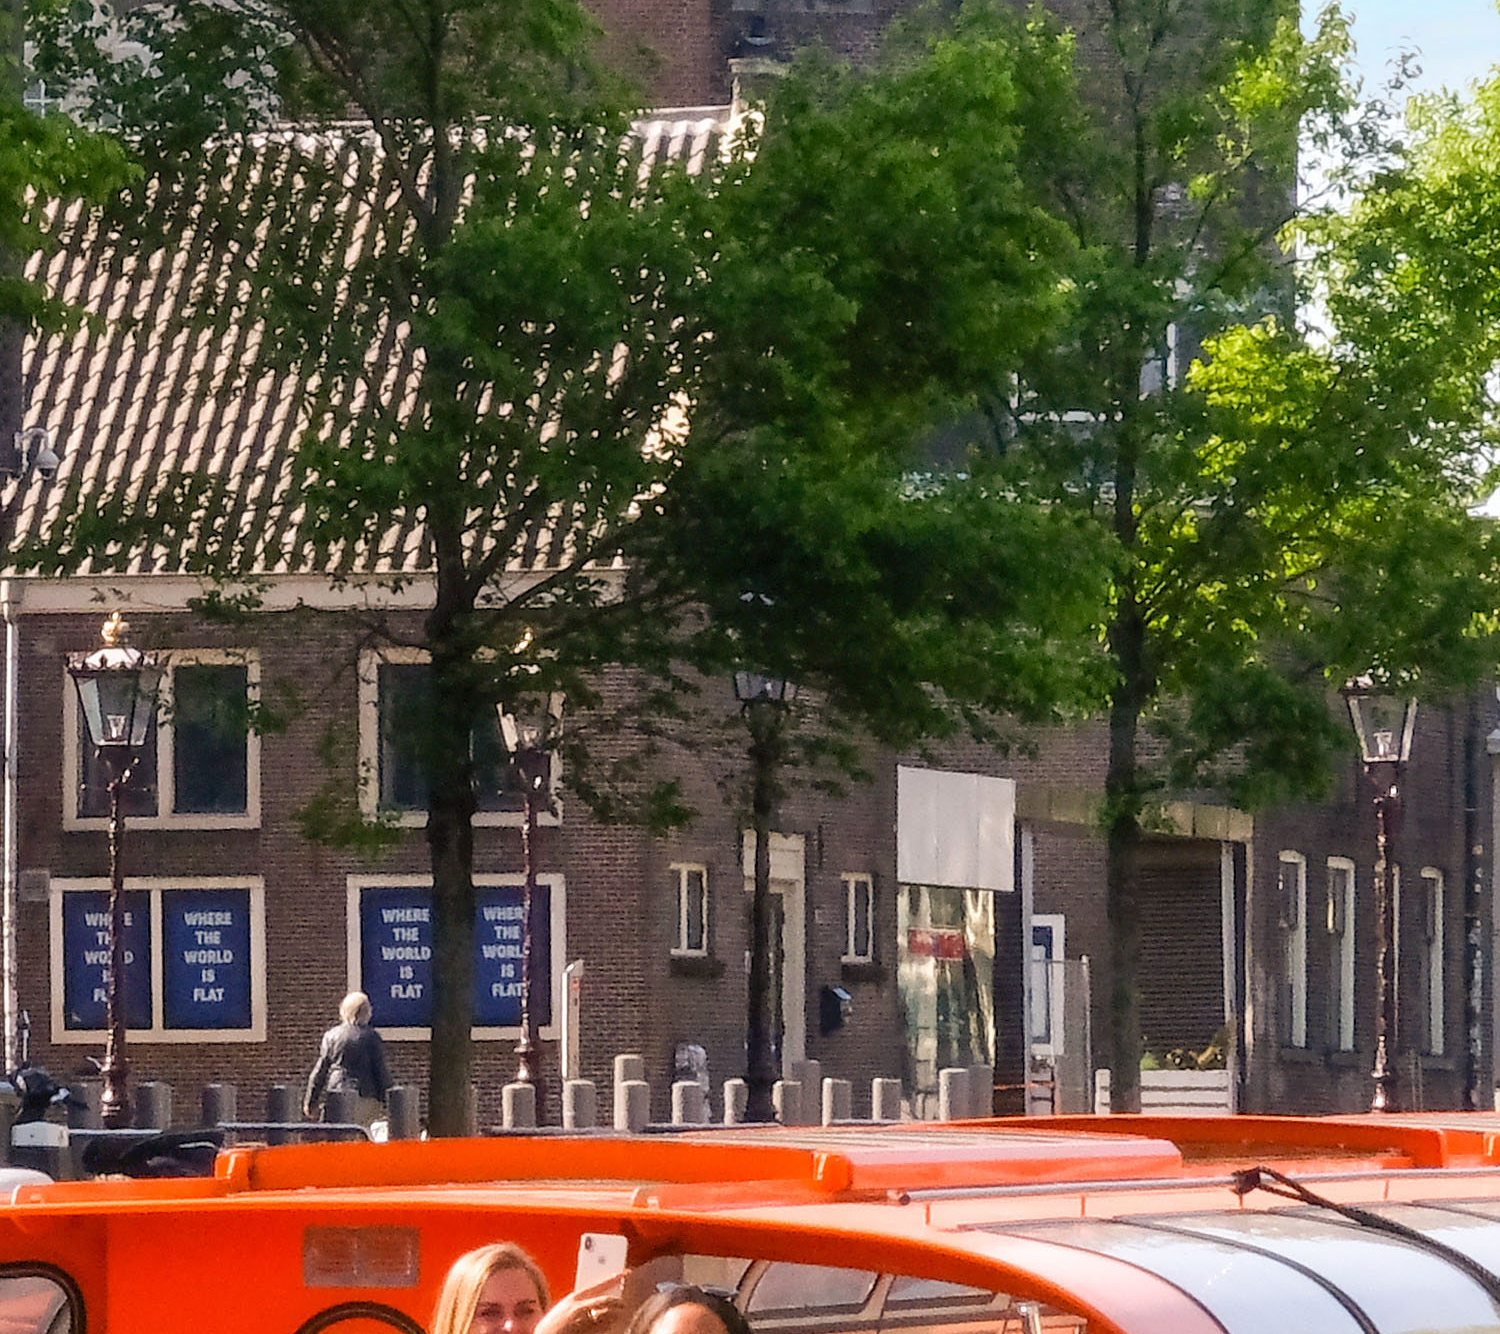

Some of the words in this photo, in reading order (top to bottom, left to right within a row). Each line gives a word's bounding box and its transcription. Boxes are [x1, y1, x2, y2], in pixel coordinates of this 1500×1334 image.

[85, 912, 133, 926] WHE
[184, 912, 232, 926] WHERE
[381, 908, 430, 923] WHERE
[483, 906, 524, 921] WHER
[195, 931, 221, 945] THE
[392, 927, 420, 942] THE
[494, 925, 520, 940] THE
[85, 950, 134, 965] WOD
[184, 950, 233, 964] WORLD
[381, 946, 431, 960] WORLD
[482, 944, 524, 959] WORL
[202, 970, 215, 983] IS
[400, 966, 413, 980] IS
[501, 964, 514, 978] IS
[193, 988, 225, 1002] FLAT
[391, 984, 423, 999] FLAT
[492, 983, 523, 997] FLAT
